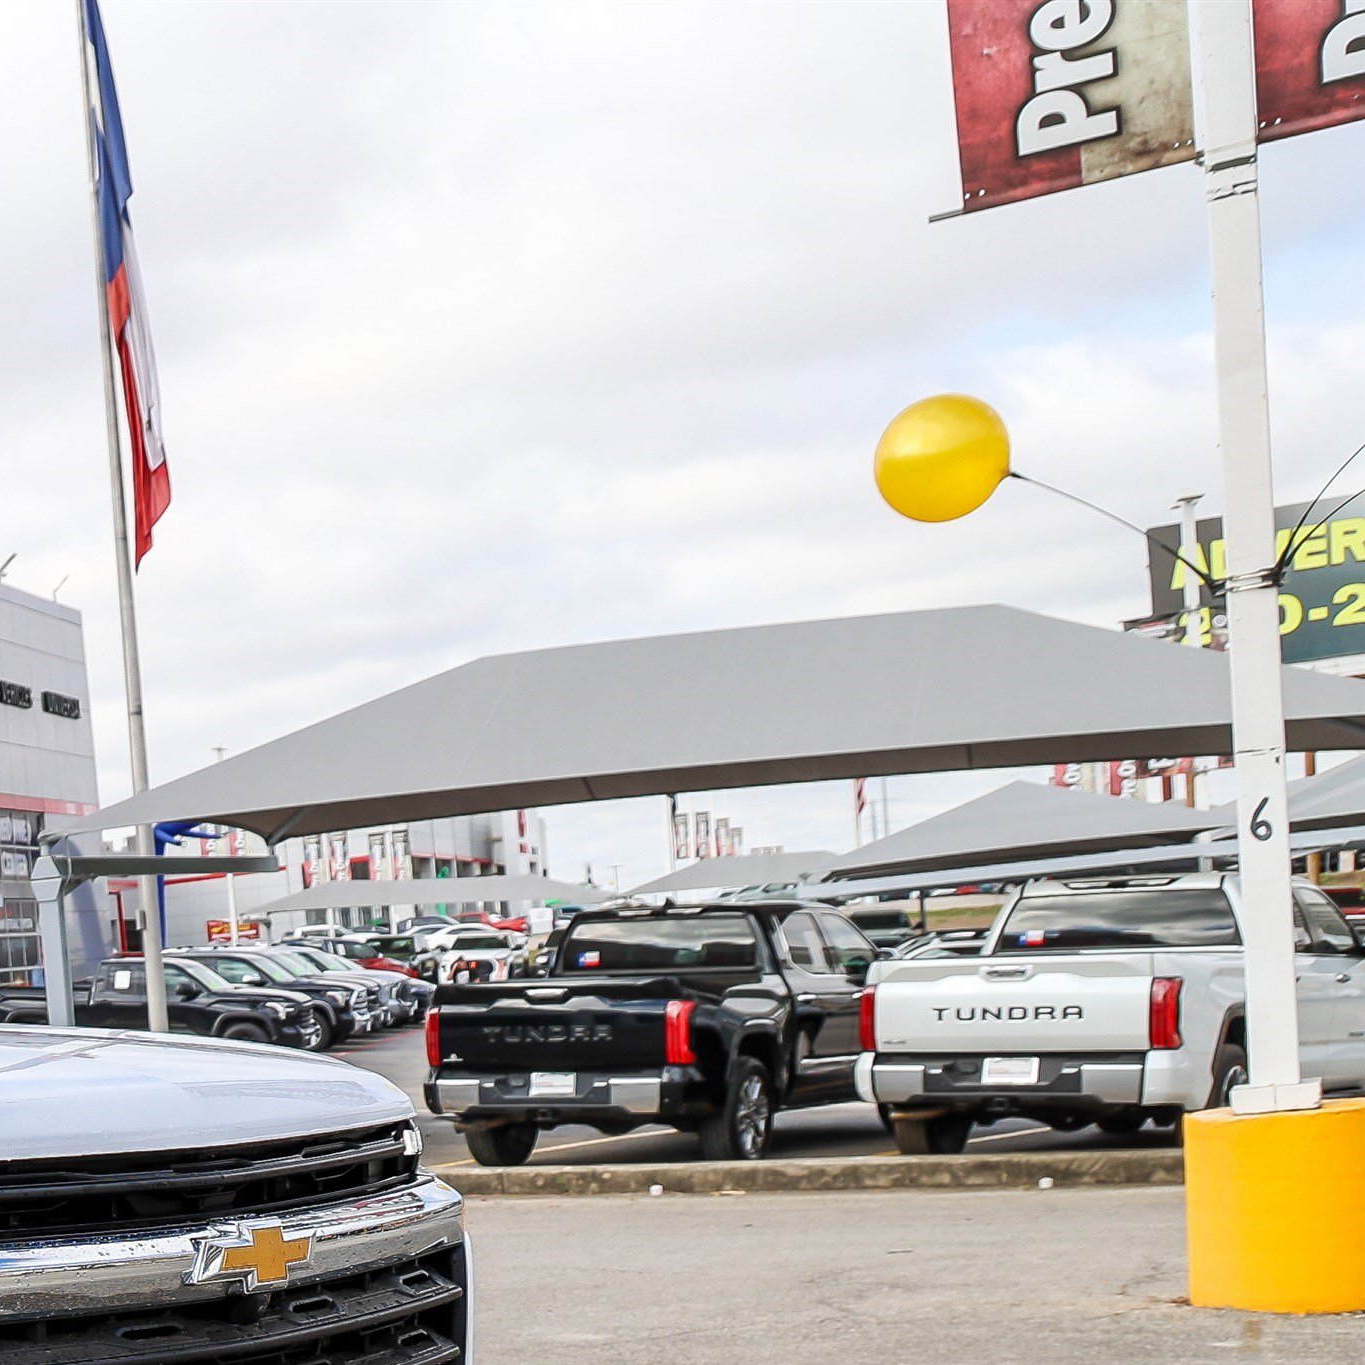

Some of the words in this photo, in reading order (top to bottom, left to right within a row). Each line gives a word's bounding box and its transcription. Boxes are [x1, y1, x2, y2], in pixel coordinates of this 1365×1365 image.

[1017, 0, 1119, 158] Pre
[1250, 796, 1272, 842] 6
[932, 1004, 1084, 1022] TUNDRA
[482, 1024, 613, 1042] TUNDRA
